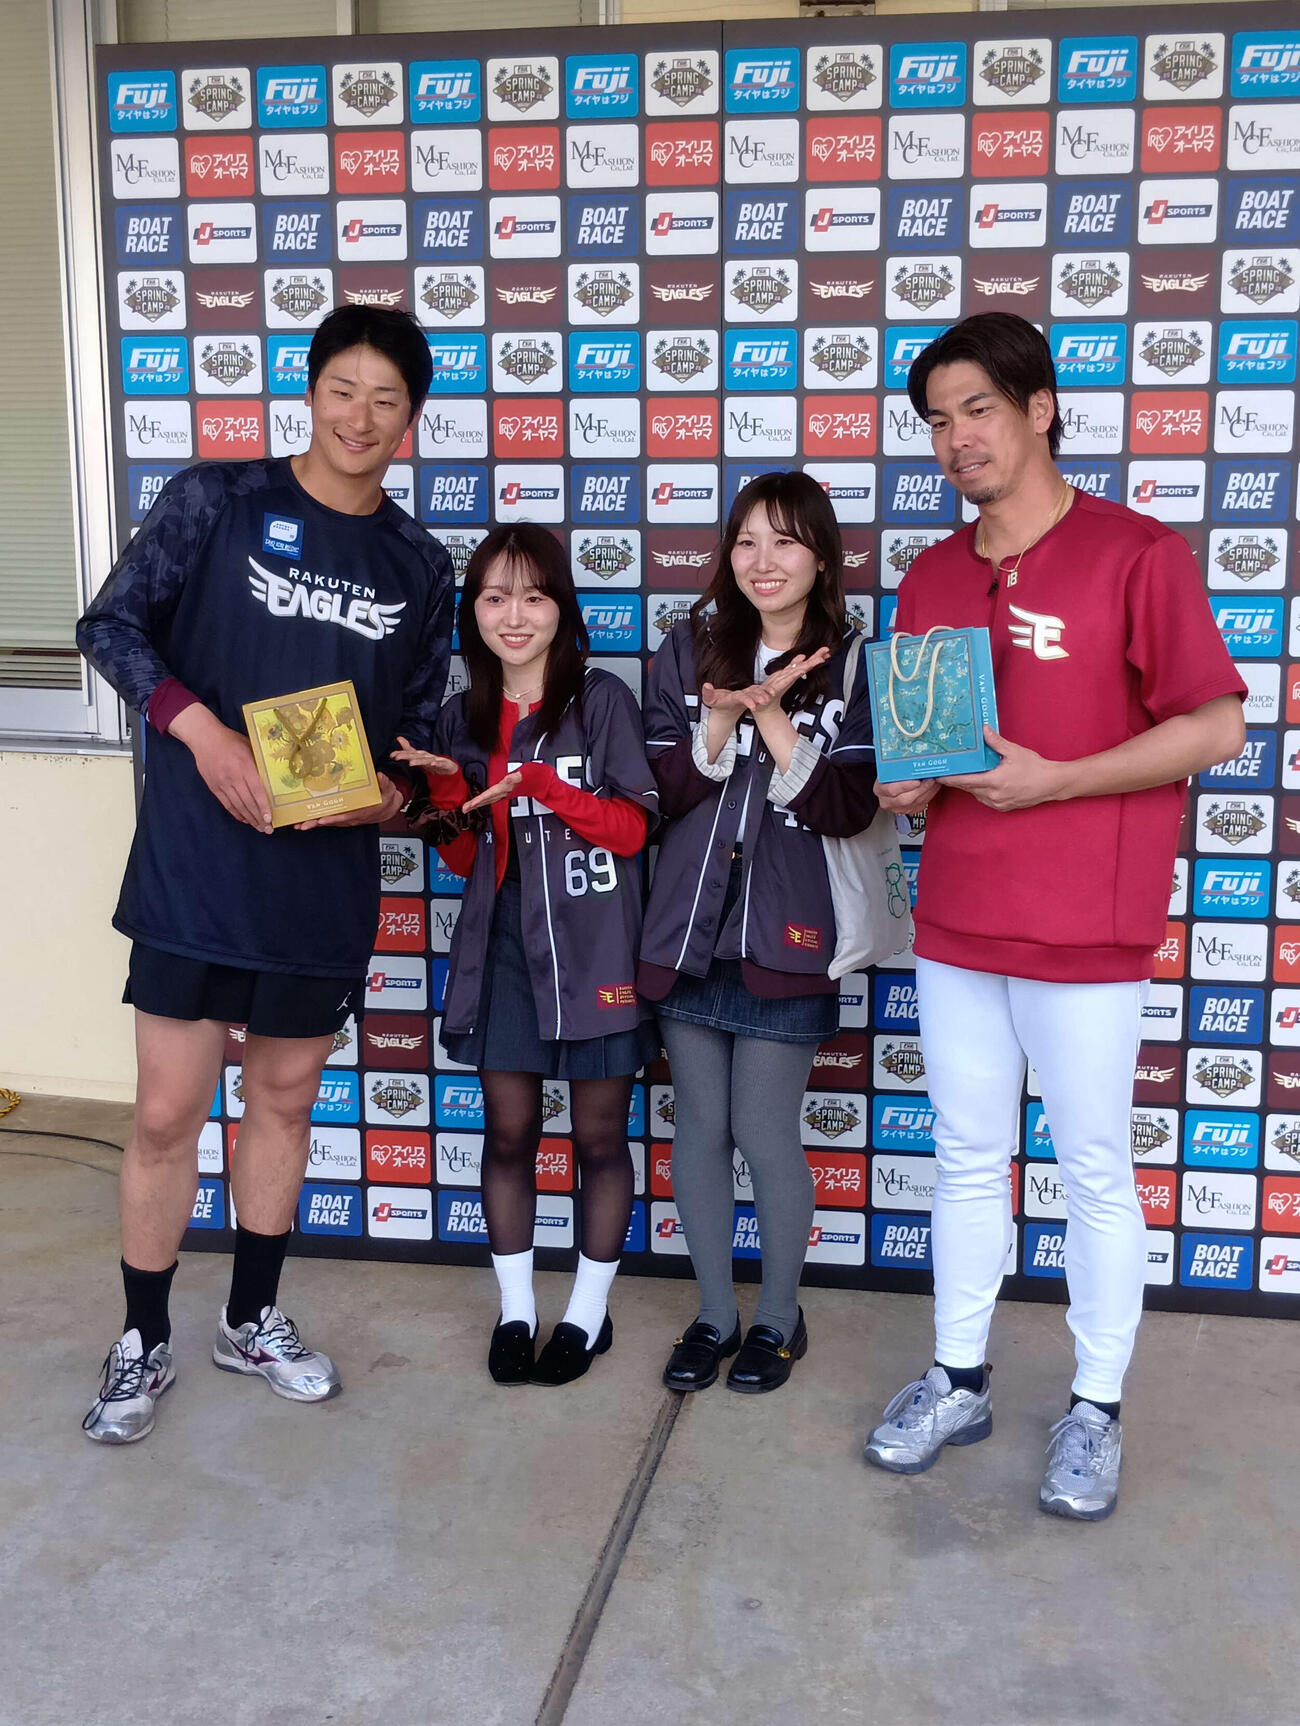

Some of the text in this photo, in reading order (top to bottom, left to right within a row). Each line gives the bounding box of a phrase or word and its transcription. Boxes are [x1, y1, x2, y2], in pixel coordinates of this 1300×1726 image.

[1066, 49, 1128, 78] Fuji
[1165, 54, 1202, 68] SPRING
[733, 60, 791, 88] Fuji
[826, 65, 862, 79] SPRING
[1171, 68, 1197, 80] CAMP
[417, 72, 472, 99] Fuji
[506, 77, 539, 90] SPRING
[833, 78, 857, 91] CAMP
[1067, 78, 1126, 90] タイヤはフジ
[115, 82, 168, 109] Fuji
[200, 87, 232, 100] SPRING
[512, 90, 535, 102] CAMP
[734, 88, 790, 100] タイヤはフジ
[206, 100, 228, 111] CAMP
[418, 100, 471, 110] タイヤはフジ
[117, 109, 168, 120] タイヤはフジ
[1003, 130, 1042, 143] アイリス
[675, 140, 712, 152] アイリス
[1003, 144, 1042, 157] オーヤマ
[363, 149, 399, 162] アイリス
[675, 154, 712, 166] オーヤマ
[364, 163, 399, 175] オーヤマ
[1068, 194, 1121, 213] BOAT
[738, 202, 788, 221] BOAT
[1167, 207, 1206, 215] SPORTS
[127, 216, 172, 234] BOAT
[426, 210, 473, 228] BOAT
[832, 215, 869, 223] SPORTS
[1064, 214, 1116, 232] RACE
[212, 229, 246, 237] SPORTS
[515, 223, 550, 231] SPORTS
[735, 221, 784, 240] RACE
[124, 235, 170, 252] RACE
[422, 229, 469, 247] RACE
[1242, 269, 1279, 282] SPRING
[586, 282, 620, 295] SPRING
[905, 276, 940, 289] SPRING
[981, 278, 1031, 295] EAGLES
[1248, 282, 1274, 294] CAMP
[282, 287, 314, 300] SPRING
[659, 285, 706, 301] EAGLES
[911, 289, 936, 300] CAMP
[288, 300, 311, 310] CAMP
[592, 295, 616, 306] CAMP
[1057, 335, 1117, 361] Fuji
[1153, 341, 1190, 354] SPRING
[1226, 332, 1289, 359] Fuji
[510, 351, 543, 363] SPRING
[576, 343, 632, 368] Fuji
[665, 349, 698, 362] SPRING
[732, 341, 789, 366] Fuji
[823, 346, 857, 359] SPRING
[128, 348, 180, 372] Fuji
[212, 354, 243, 366] SPRING
[829, 359, 853, 370] CAMP
[1159, 354, 1185, 366] CAMP
[1227, 360, 1286, 370] タイヤはフジ
[218, 366, 240, 376] CAMP
[516, 363, 539, 374] CAMP
[671, 362, 694, 372] CAMP
[733, 367, 787, 377] タイヤはフジ
[1058, 363, 1115, 373] タイヤはフジ
[130, 373, 180, 382] タイヤはフジ
[577, 370, 630, 379] タイヤはフジ
[522, 416, 557, 427] アイリス
[676, 415, 712, 426] アイリス
[833, 413, 870, 425] アイリス
[1162, 409, 1201, 421] アイリス
[224, 417, 258, 428] アイリス
[1161, 423, 1201, 435] オーヤマ
[224, 430, 259, 441] オーヤマ
[522, 429, 557, 440] オーヤマ
[676, 428, 712, 440] オーヤマ
[833, 426, 870, 438] オーヤマ
[432, 476, 478, 493] BOAT
[583, 476, 630, 493] BOAT
[896, 474, 946, 492] BOAT
[1226, 472, 1279, 490] BOAT
[429, 494, 475, 510] RACE
[580, 494, 627, 510] RACE
[892, 493, 941, 510] RACE
[1222, 491, 1274, 508] RACE
[589, 548, 622, 560] SPRING
[660, 552, 705, 567] EAGLES
[1229, 548, 1265, 560] SPRING
[595, 560, 618, 570] CAMP
[1235, 560, 1260, 571] CAMP
[289, 567, 376, 599] RAKUTEN
[258, 568, 395, 640] EAGLES
[1214, 608, 1274, 633] Fuji
[1217, 812, 1252, 825] SPRING
[1222, 824, 1247, 836] CAMP
[565, 847, 618, 897] 69
[1202, 870, 1262, 895] Fuji
[386, 912, 420, 925] アイリス
[386, 925, 420, 936] オーヤマ
[1203, 997, 1254, 1015] BOAT
[1199, 1014, 1249, 1032] RACE
[897, 1064, 920, 1074] CAMP
[1206, 1066, 1241, 1079] SPRING
[1212, 1078, 1236, 1089] CAMP
[381, 1089, 411, 1100] SPRING
[387, 1100, 408, 1110] CAMP
[815, 1109, 848, 1121] SPRING
[821, 1120, 843, 1130] CAMP
[1192, 1121, 1250, 1146] Fuji
[392, 1145, 425, 1157] アイリス
[392, 1157, 425, 1168] オーヤマ
[825, 1167, 860, 1179] アイリス
[825, 1179, 860, 1191] オーヤマ
[310, 1194, 352, 1210] BOAT
[307, 1209, 350, 1225] RACE
[390, 1209, 422, 1217] SPORTS
[821, 1234, 855, 1242] SPORTS
[884, 1225, 930, 1243] BOAT
[880, 1241, 926, 1258] RACE
[1194, 1244, 1243, 1262] BOAT
[1190, 1260, 1238, 1278] RACE
